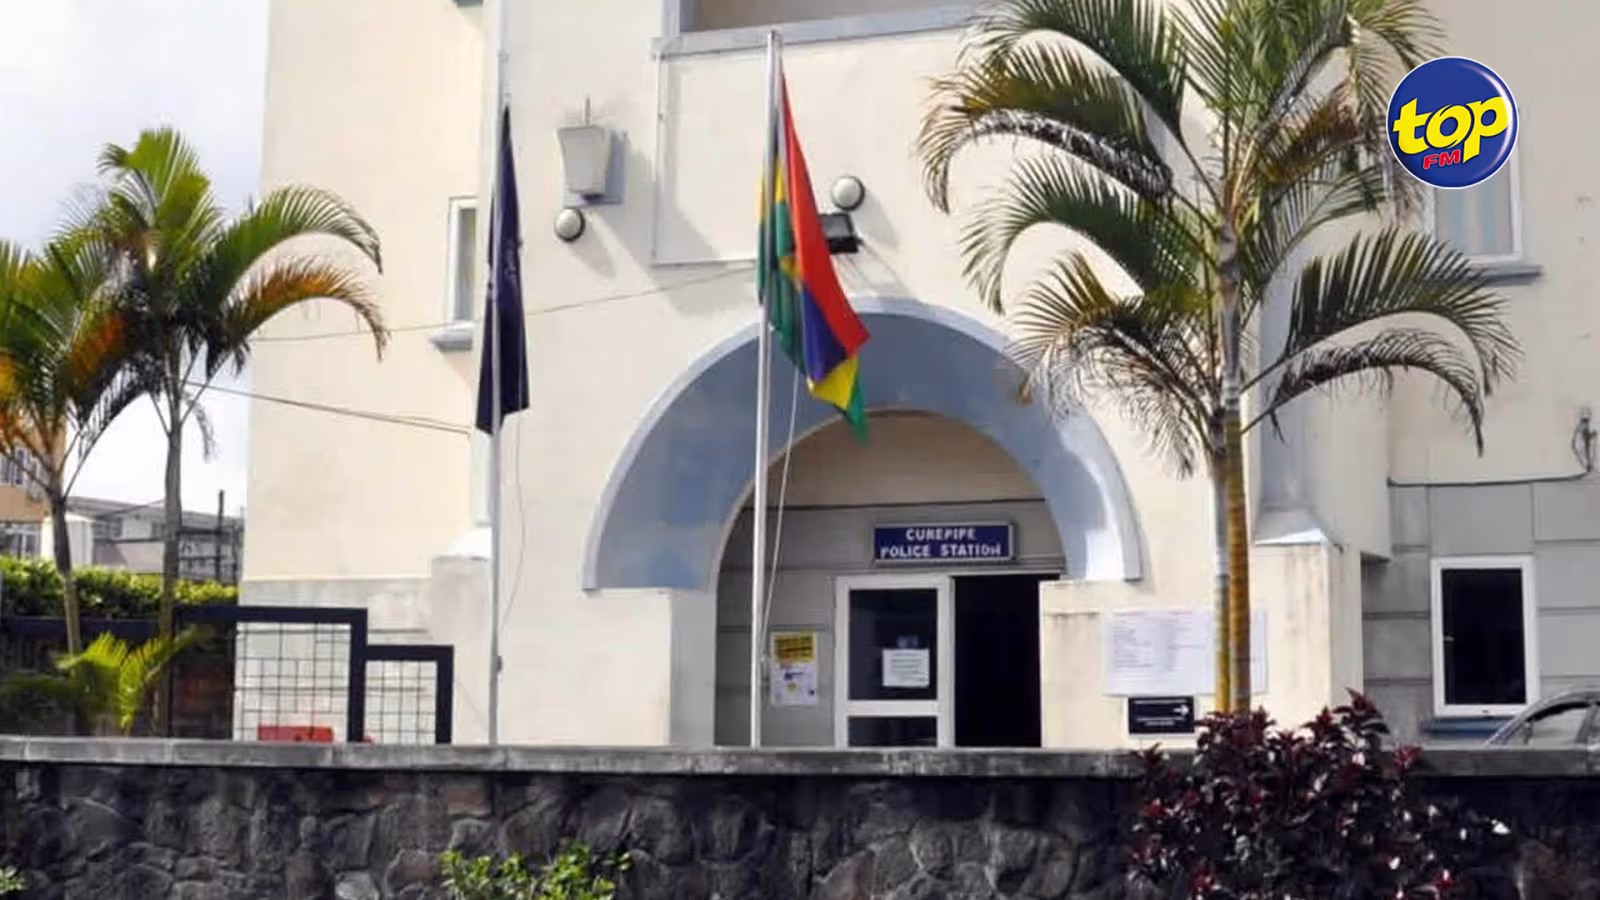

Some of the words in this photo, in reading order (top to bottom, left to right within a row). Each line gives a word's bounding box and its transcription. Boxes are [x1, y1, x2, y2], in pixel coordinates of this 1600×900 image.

[905, 527, 977, 541] CUREPIPE
[879, 544, 931, 558] POLICE
[940, 542, 1001, 557] STATION
